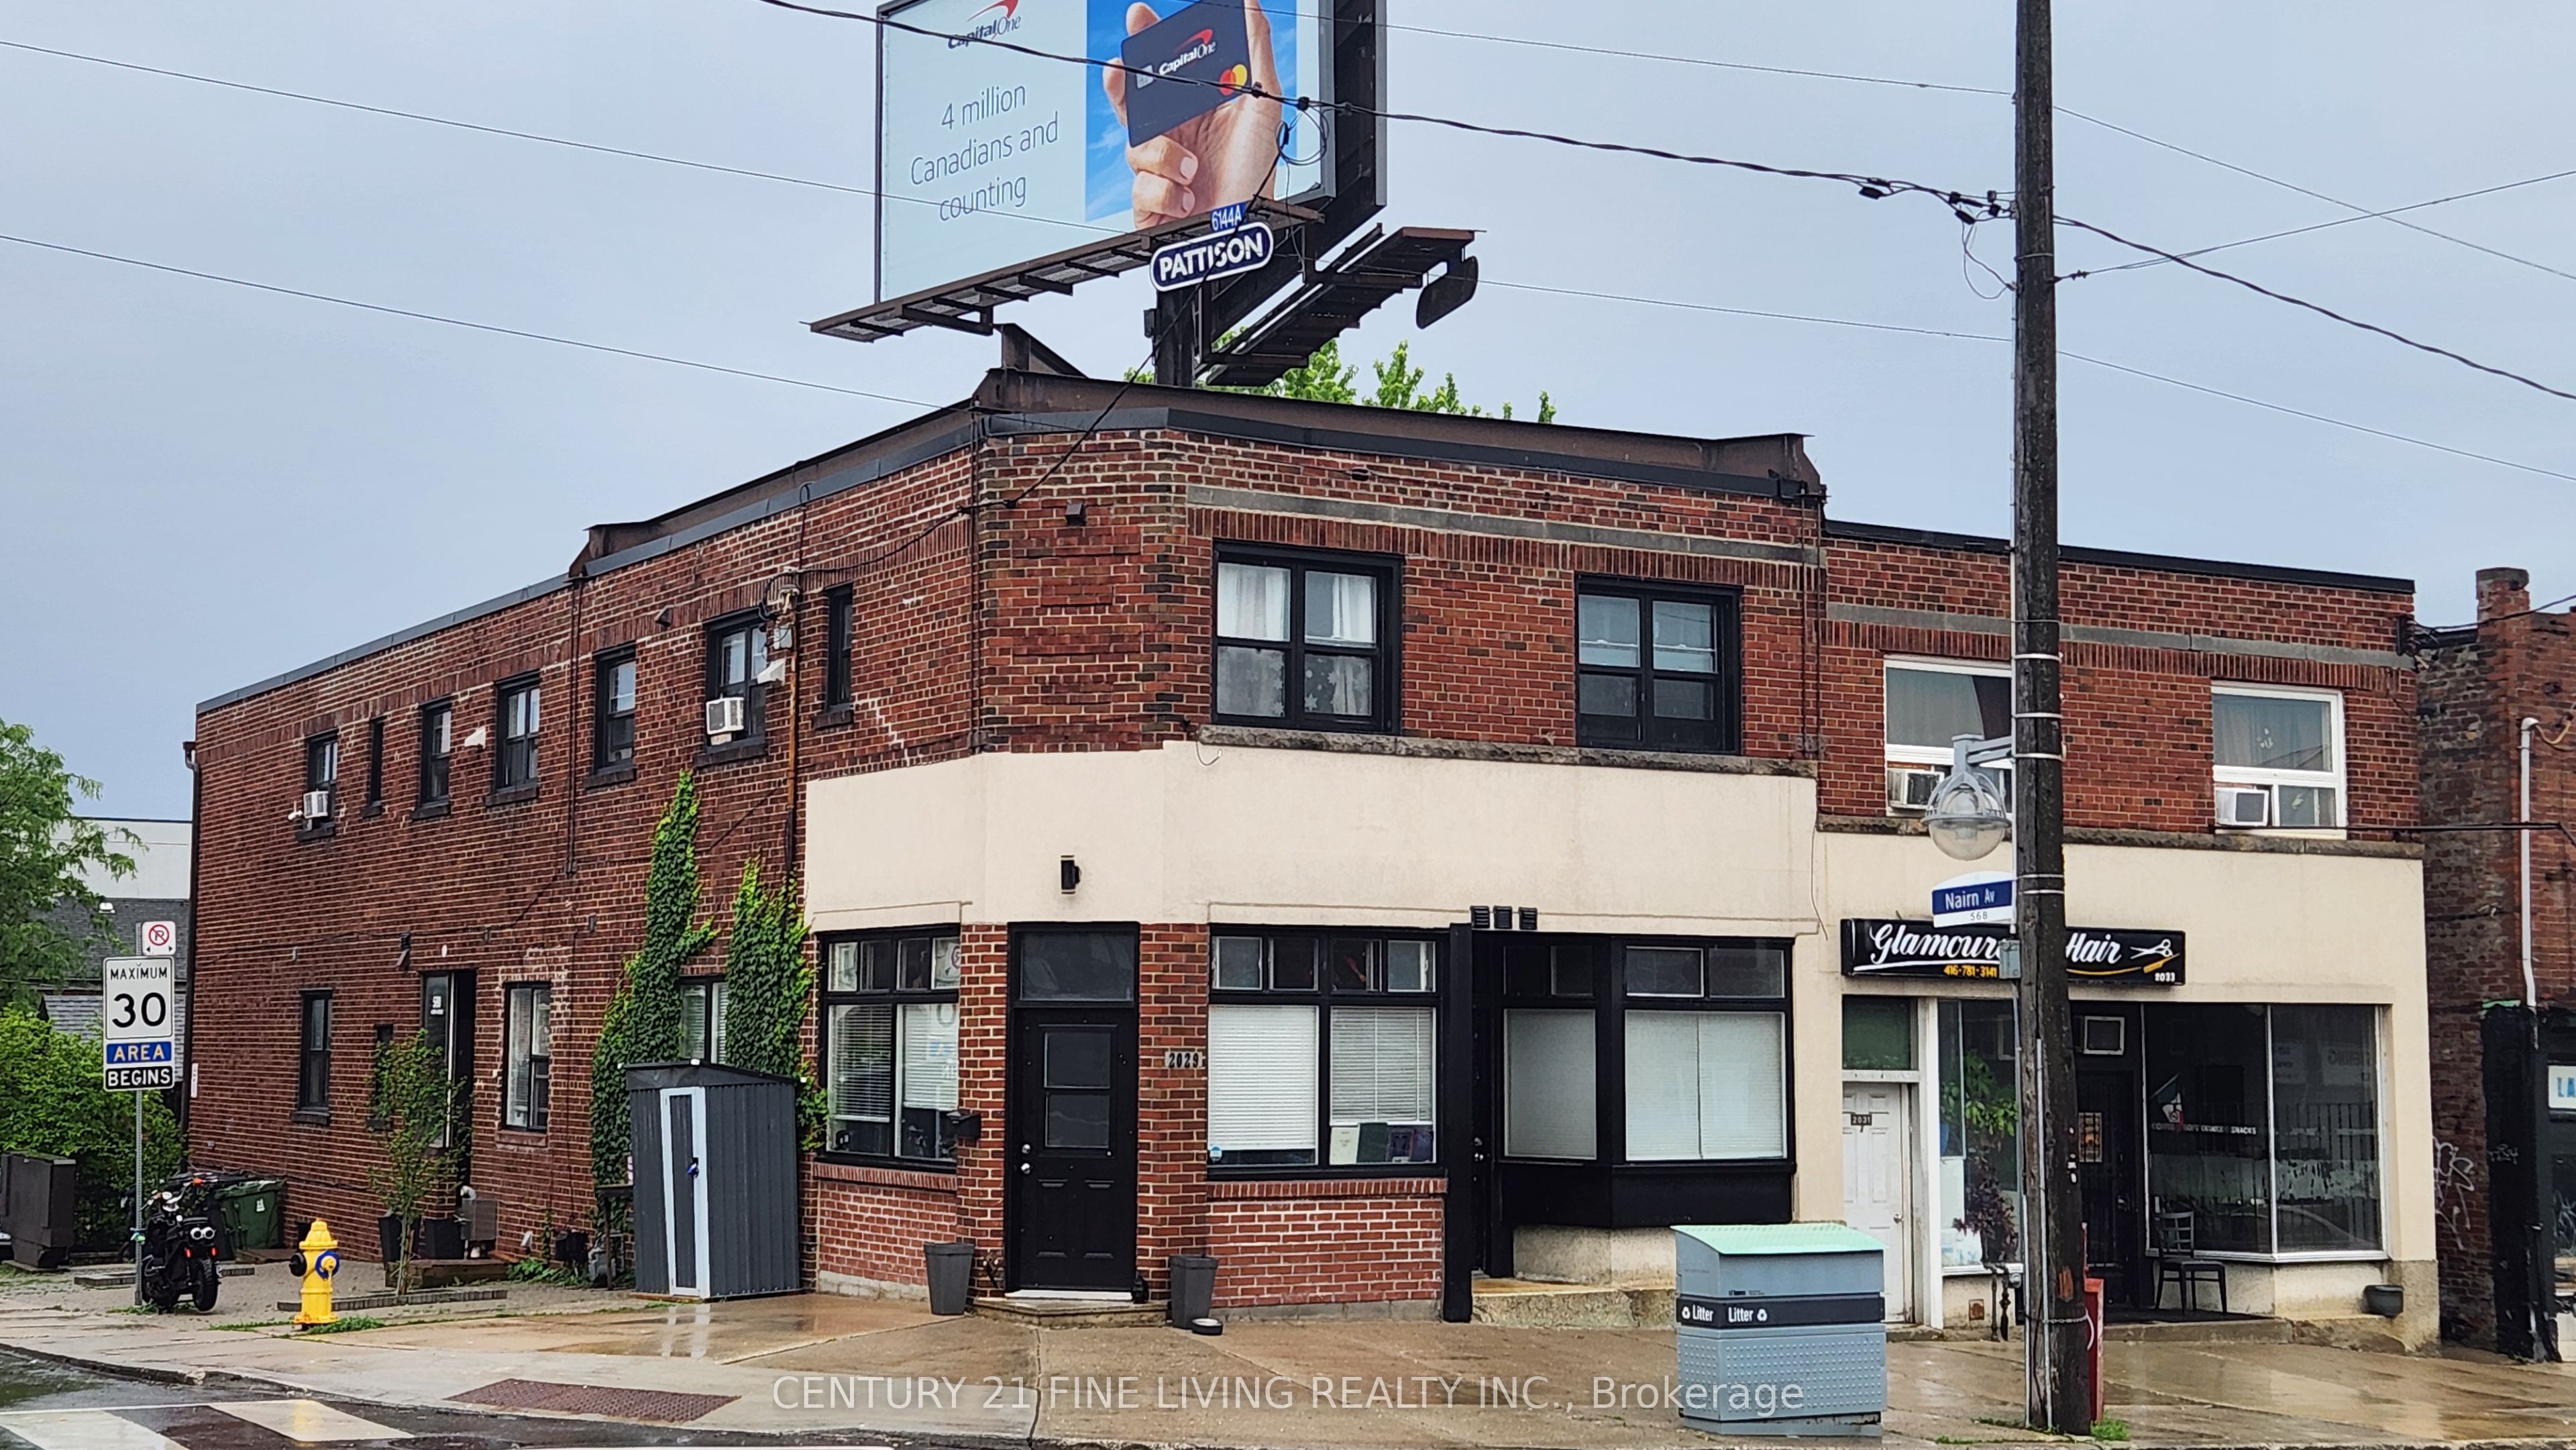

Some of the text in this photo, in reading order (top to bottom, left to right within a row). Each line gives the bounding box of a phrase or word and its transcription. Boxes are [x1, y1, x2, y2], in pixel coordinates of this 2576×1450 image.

[941, 86, 1026, 130] 4 million
[911, 110, 1058, 185] Canadians and
[940, 176, 1026, 221] counting
[1211, 205, 1242, 231] 6144A
[1159, 232, 1263, 281] PATTISON
[1945, 888, 1996, 911] Nairn Av
[1970, 911, 1988, 921] 568
[1869, 924, 2123, 964] Glamour Hair
[110, 967, 168, 980] MAXIMUM
[2154, 972, 2176, 982] 2033
[111, 992, 166, 1028] 30
[113, 1044, 166, 1062] AREA
[1168, 1052, 1199, 1068] 2029
[108, 1068, 170, 1086] BEGINS
[1852, 1116, 1870, 1124] 2031
[1692, 1304, 1714, 1322] Litter
[1728, 1306, 1754, 1323] Litter
